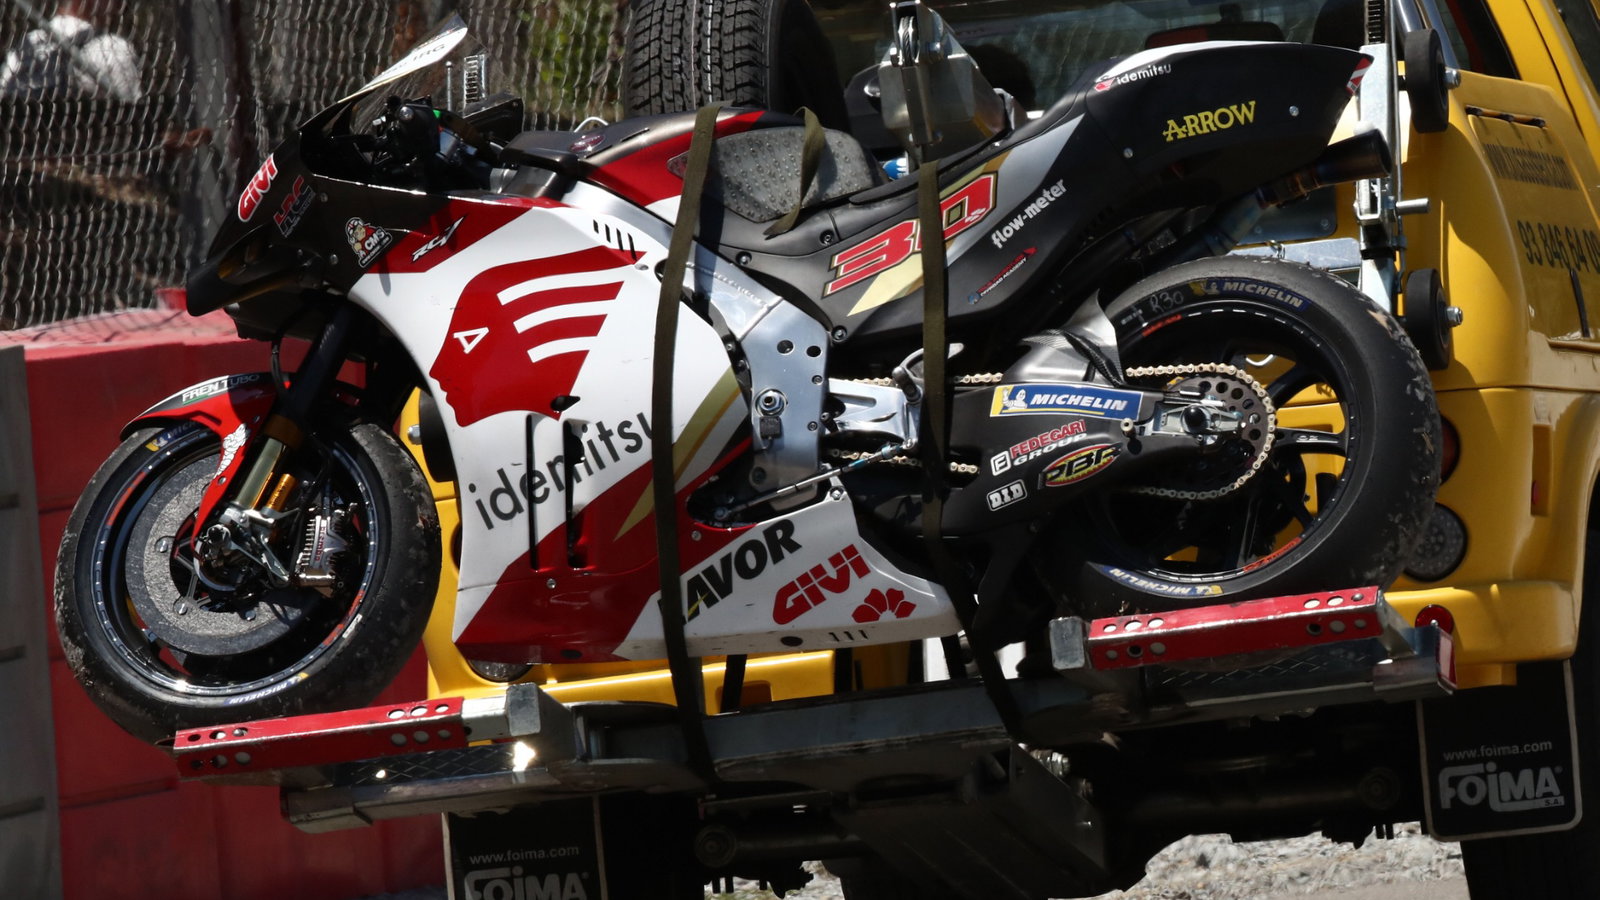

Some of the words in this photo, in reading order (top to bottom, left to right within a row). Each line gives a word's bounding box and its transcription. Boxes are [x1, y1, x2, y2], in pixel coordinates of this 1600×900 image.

[1116, 63, 1172, 86] idemitsu
[1162, 100, 1257, 142] ARROW
[238, 153, 278, 222] GIVI
[273, 174, 317, 236] HRC
[990, 179, 1068, 250] flow-meter
[364, 228, 385, 251] CMS
[821, 171, 998, 299] 30
[1517, 219, 1543, 266] 93
[1222, 281, 1304, 308] MICHELIN
[1030, 393, 1128, 411] MICHELIN
[1010, 419, 1087, 460] FEDEGARI
[1013, 433, 1088, 466] GROUP
[657, 519, 802, 627] AVOR
[772, 544, 871, 625] GIVI
[1109, 567, 1192, 595] MICHELIN
[229, 683, 288, 704] MICHELIN
[1442, 740, 1553, 761] www.foima.com
[469, 845, 580, 865] www.foima.com
